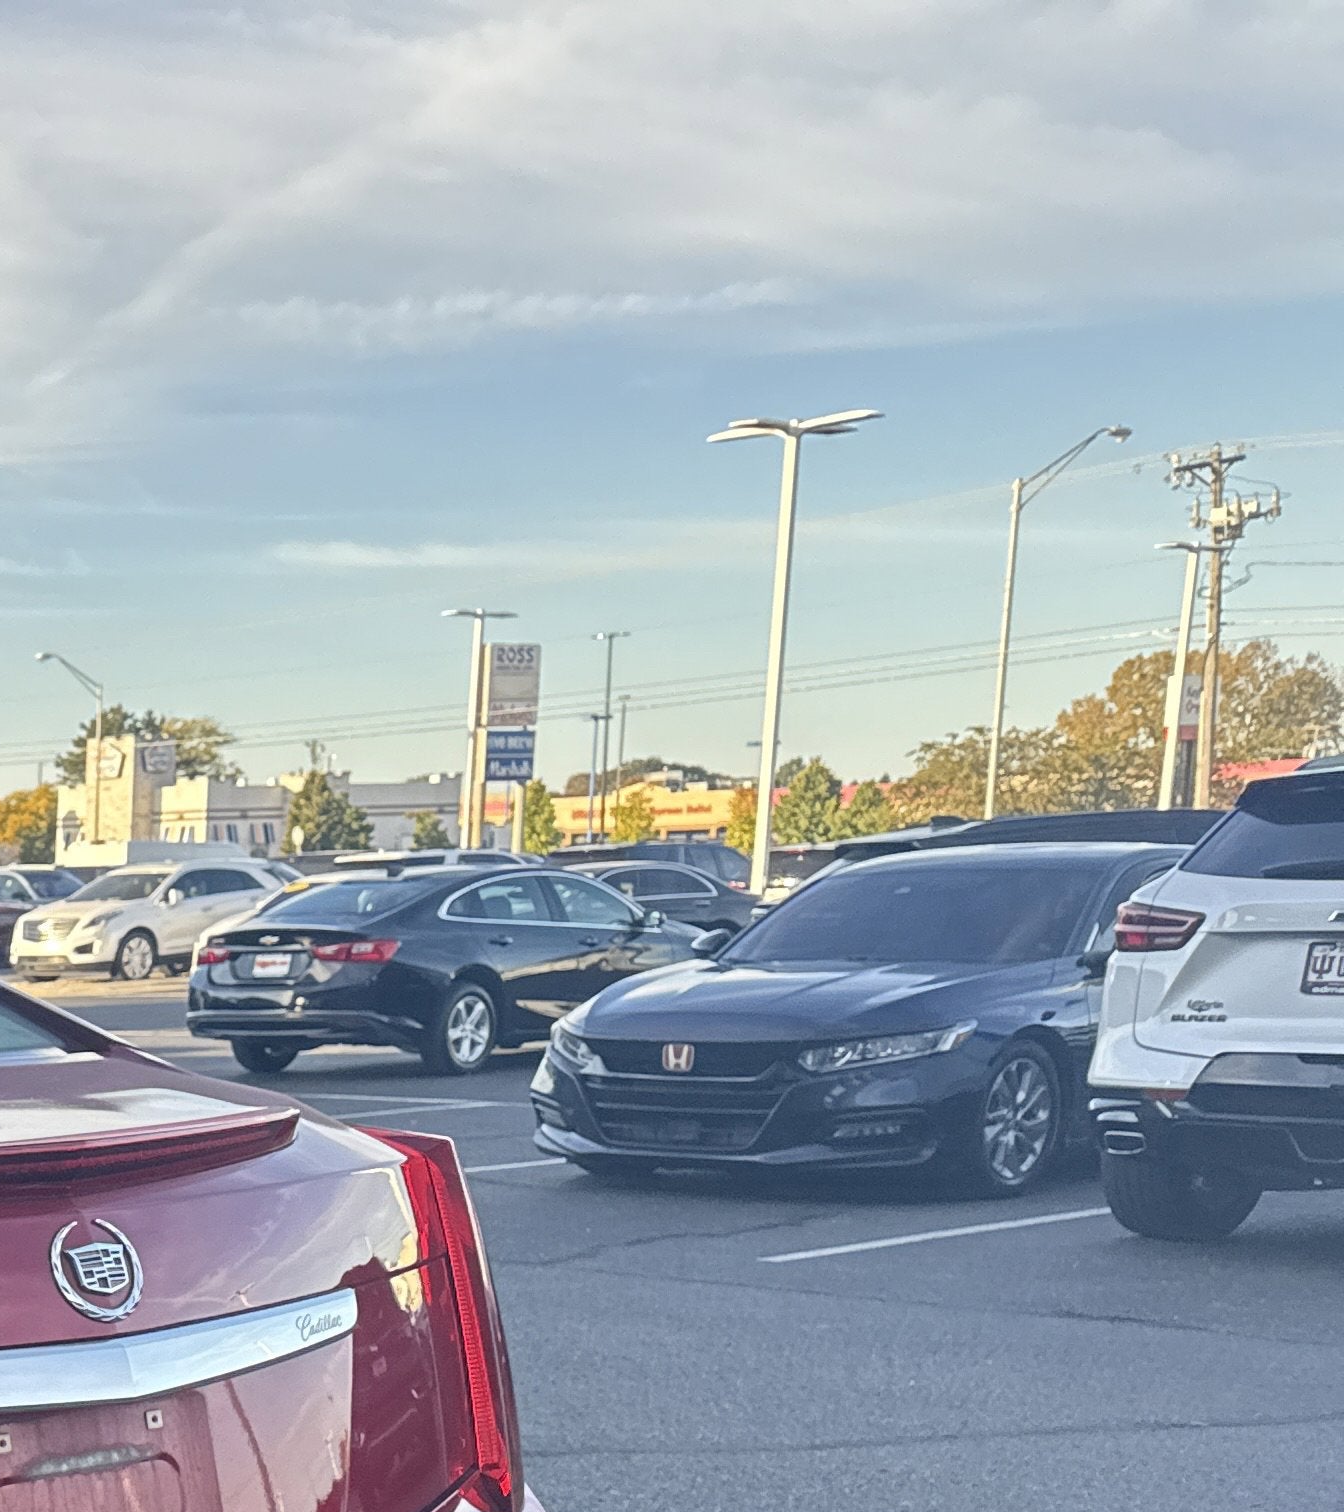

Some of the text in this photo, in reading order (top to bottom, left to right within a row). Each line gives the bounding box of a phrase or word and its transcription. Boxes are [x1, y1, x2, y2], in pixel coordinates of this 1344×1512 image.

[496, 647, 535, 663] ROSS
[1170, 1014, 1228, 1023] BLAZER
[295, 1313, 342, 1342] Cadillac
